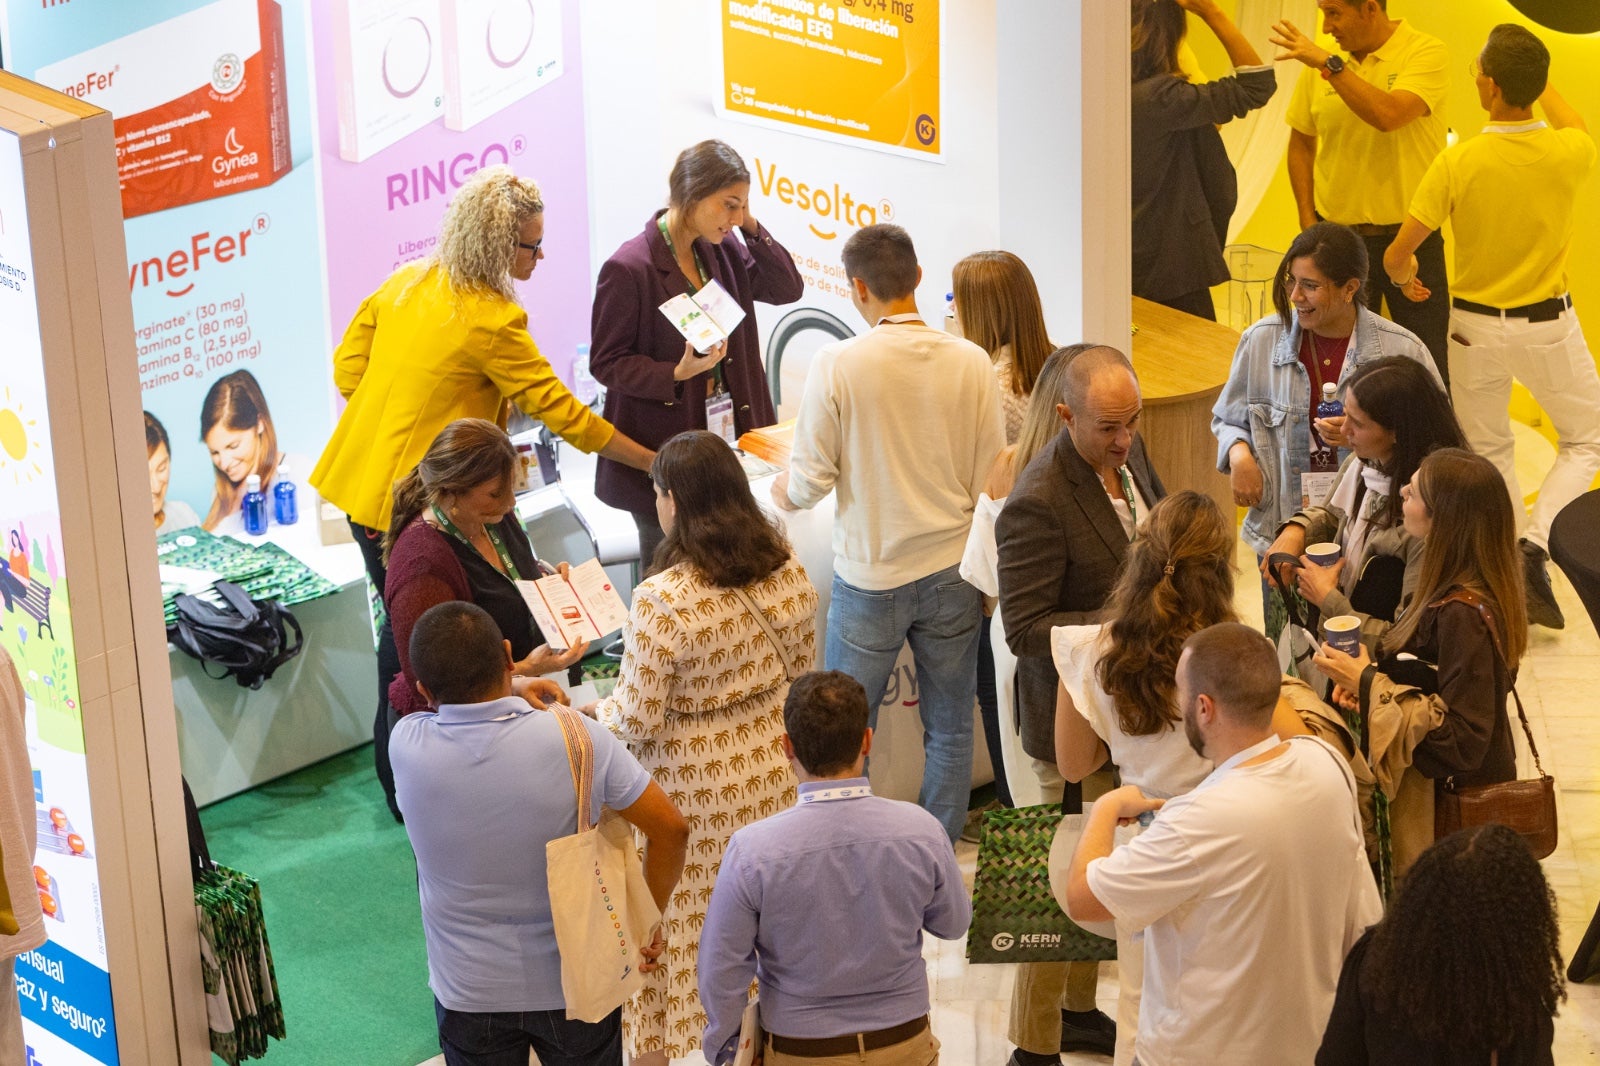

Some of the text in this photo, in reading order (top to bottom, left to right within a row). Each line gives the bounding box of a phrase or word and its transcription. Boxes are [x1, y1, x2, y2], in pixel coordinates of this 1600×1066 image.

[729, 1, 833, 40] modificada EFG
[818, 3, 834, 20] de
[837, 7, 899, 39] liberación
[891, 0, 914, 23] mg
[212, 152, 258, 176] Gynea
[213, 172, 259, 188] laboratorios
[806, 256, 820, 271] de
[817, 279, 832, 292] de
[196, 306, 217, 322] (30
[220, 293, 245, 313] mg)
[184, 328, 195, 341] C
[198, 320, 220, 339] (80
[223, 309, 248, 330] mg)
[206, 351, 233, 372] (100
[237, 339, 262, 360] mg)
[1020, 933, 1062, 943] KERN
[15, 949, 65, 984] ensual
[38, 987, 48, 1012] y
